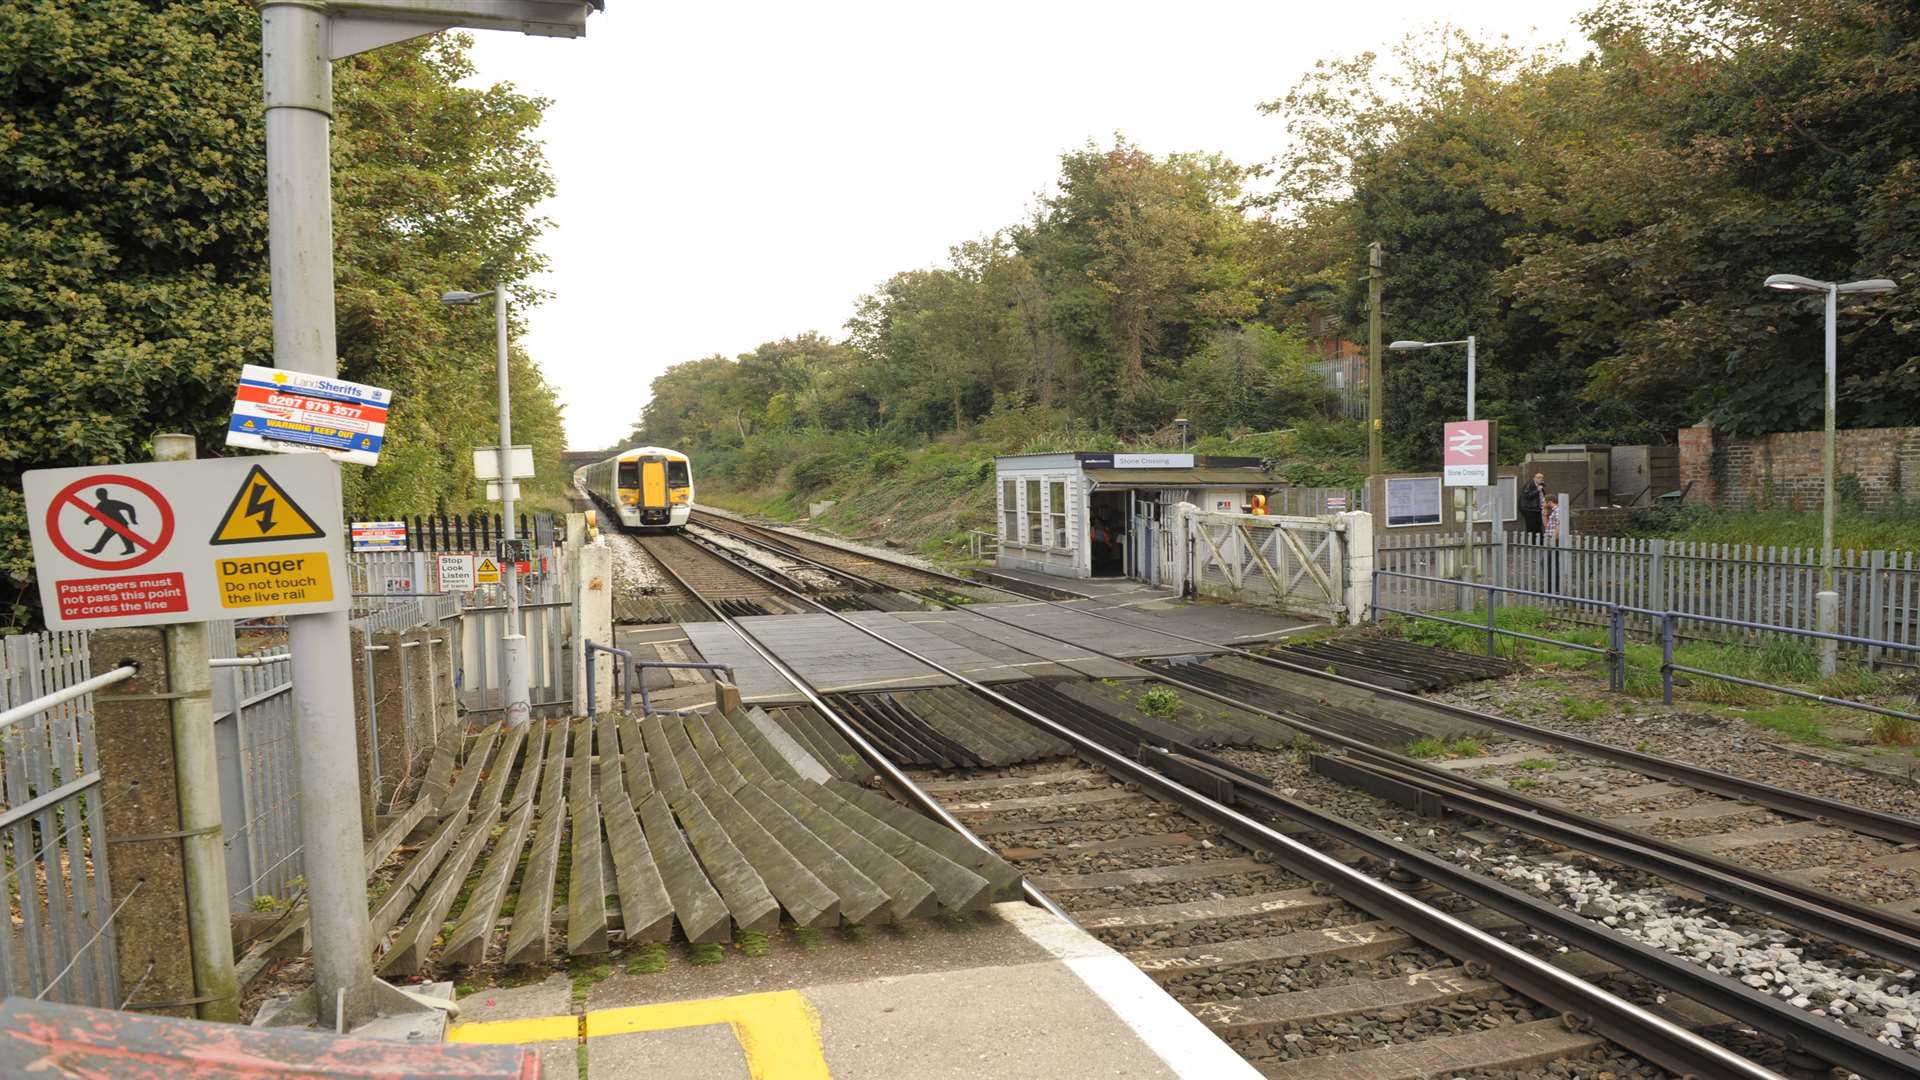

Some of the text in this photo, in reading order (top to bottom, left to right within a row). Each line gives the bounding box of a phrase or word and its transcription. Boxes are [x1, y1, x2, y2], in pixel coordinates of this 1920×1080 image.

[268, 394, 303, 407] 0207
[305, 400, 330, 412] 979
[332, 405, 362, 418] 3577
[266, 419, 311, 432] WARNING
[313, 426, 337, 436] KEEP
[338, 430, 354, 439] OUT
[1141, 457, 1169, 466] Crossing
[222, 559, 304, 575] Danger
[60, 577, 172, 593] Passengers must
[225, 576, 317, 592] Do not touch
[63, 588, 181, 604] not pass this point
[227, 589, 305, 604] the live rail
[81, 605, 118, 615] cross
[120, 602, 142, 611] the
[144, 600, 168, 610] line
